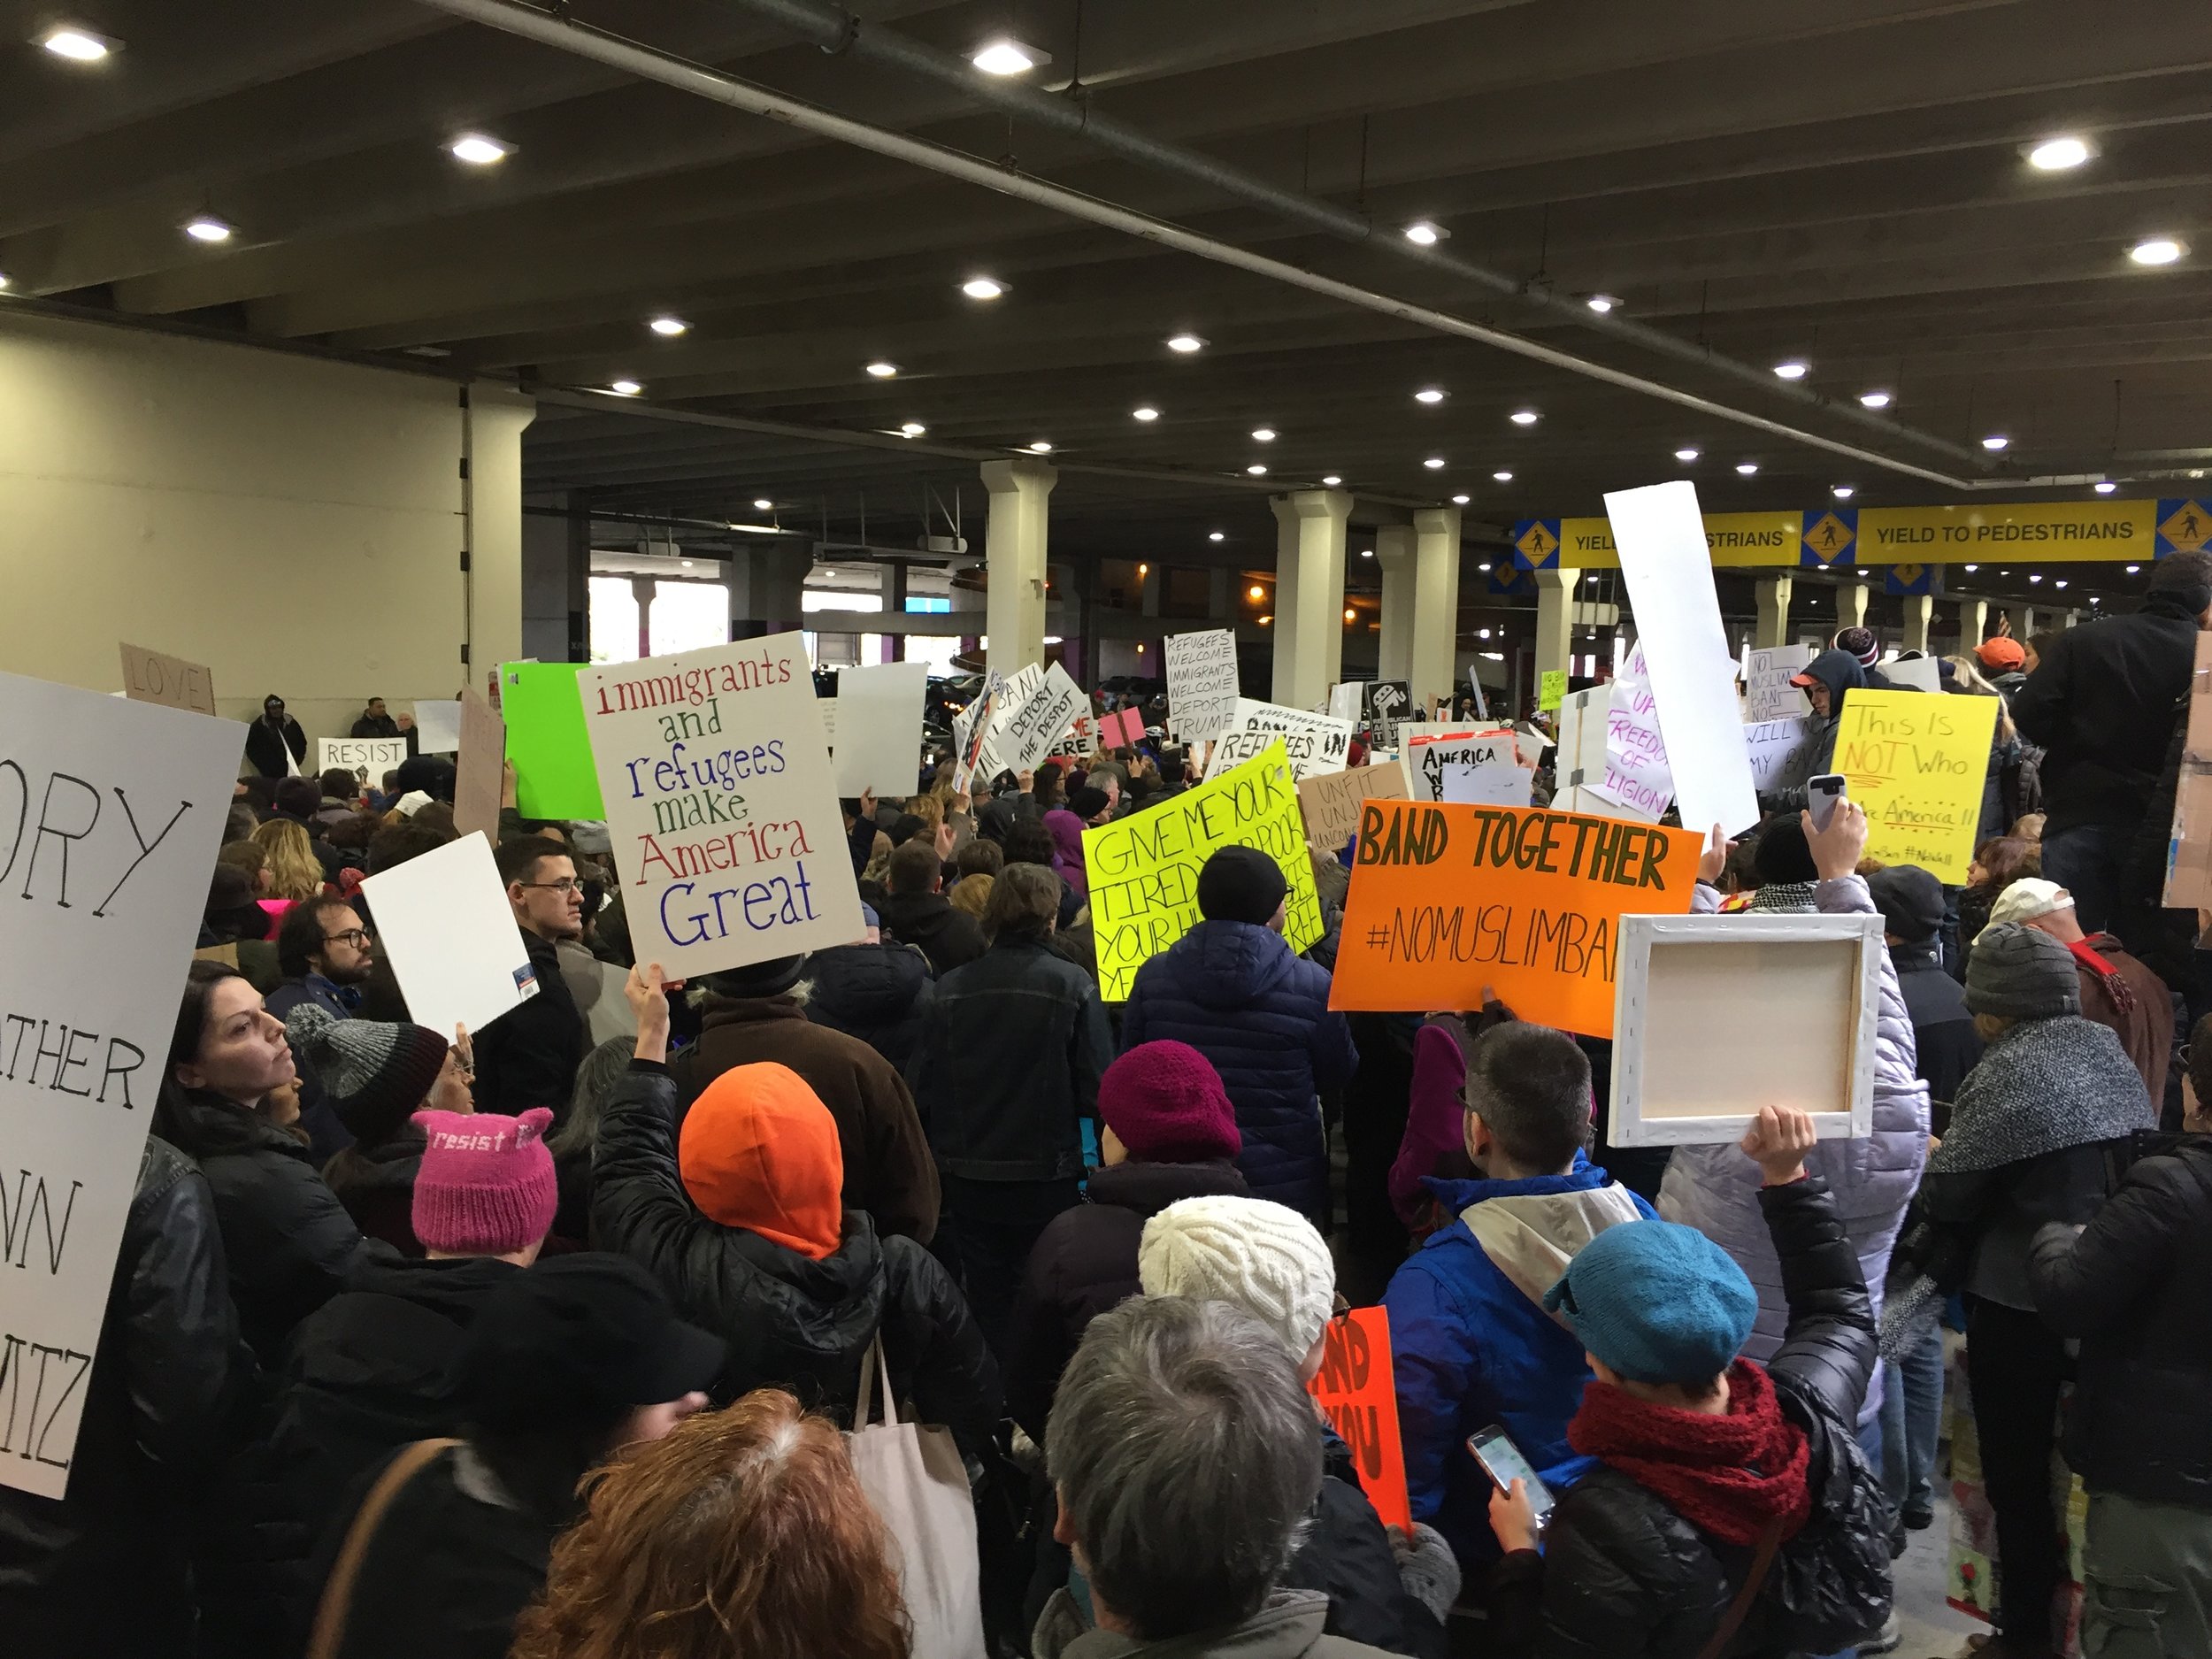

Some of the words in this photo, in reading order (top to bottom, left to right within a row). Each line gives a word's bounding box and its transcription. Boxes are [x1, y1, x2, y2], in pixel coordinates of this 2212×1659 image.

[1706, 531, 1784, 549] STRIANS
[1877, 527, 1935, 544] YIELD
[1942, 526, 1970, 543] TO
[1977, 522, 2134, 541] PEDESTRIANS
[1167, 633, 1231, 652] REFUGEES
[1168, 646, 1233, 666] WELCOME
[1169, 662, 1236, 683] IMMIGRANTS
[1751, 672, 1792, 690] MUSLIM
[1754, 655, 1768, 674] NO
[132, 657, 206, 710] LOVE
[596, 649, 791, 716] immigrants
[1170, 677, 1233, 699] WELCOME
[1751, 688, 1778, 709] BAN
[657, 697, 723, 743] and
[1010, 677, 1054, 739] DEPORT
[1171, 695, 1236, 716] DEPORT
[1847, 704, 1915, 736] This
[1019, 735, 1039, 764] THE
[1037, 689, 1072, 738] DESPOT
[1608, 709, 1669, 766] FREEDO
[327, 742, 403, 764] RESIST
[1048, 738, 1091, 757] ERE
[1324, 733, 1347, 757] IN
[1620, 750, 1650, 768] OF
[1841, 740, 1909, 774] NOT
[1912, 744, 1969, 775] Who
[626, 739, 786, 798] refugees
[1749, 753, 1773, 775] MY
[1317, 768, 1379, 803] UNFIT
[1605, 766, 1667, 814] LIGION
[652, 788, 749, 835] make
[1094, 810, 1184, 875] GIVE
[1183, 793, 1224, 849] ME
[1221, 763, 1285, 827] YOUR
[1882, 799, 1956, 826] America
[635, 819, 814, 886] America
[1089, 862, 1200, 922] TIRED
[1256, 803, 1305, 860] POOR
[1356, 806, 1449, 866] BAND
[1472, 810, 1669, 891] TOGETHER
[660, 860, 822, 947] Great
[1095, 918, 1173, 964] YOUR
[1281, 894, 1324, 954] REE
[0, 1013, 145, 1110] THER
[432, 1130, 506, 1152] resist
